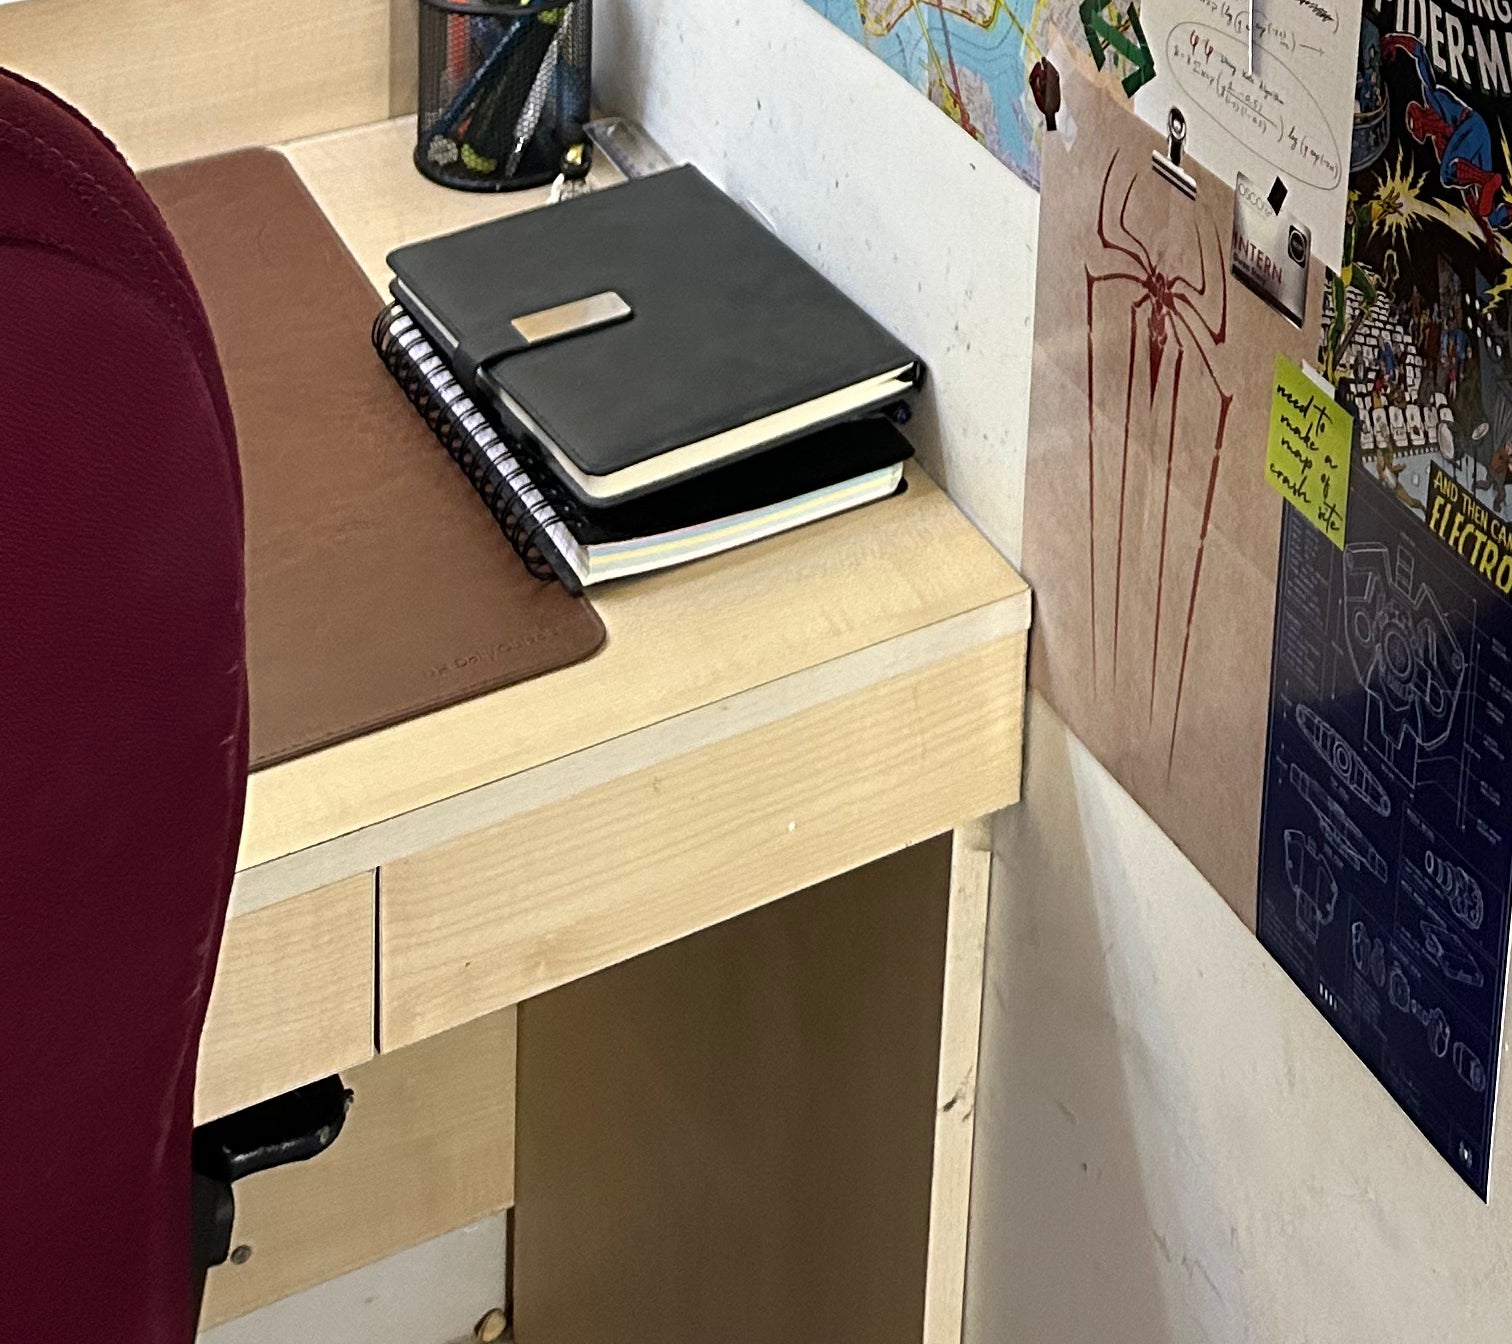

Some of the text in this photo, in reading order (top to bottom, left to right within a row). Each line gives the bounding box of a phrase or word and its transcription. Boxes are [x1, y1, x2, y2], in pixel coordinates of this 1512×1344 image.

[1233, 231, 1282, 285] INTERN
[1277, 385, 1333, 436] need to
[1281, 415, 1319, 451] make
[1281, 437, 1312, 474] map
[1270, 463, 1311, 503] crash
[1433, 471, 1457, 503] AND
[1462, 493, 1489, 530] THEN
